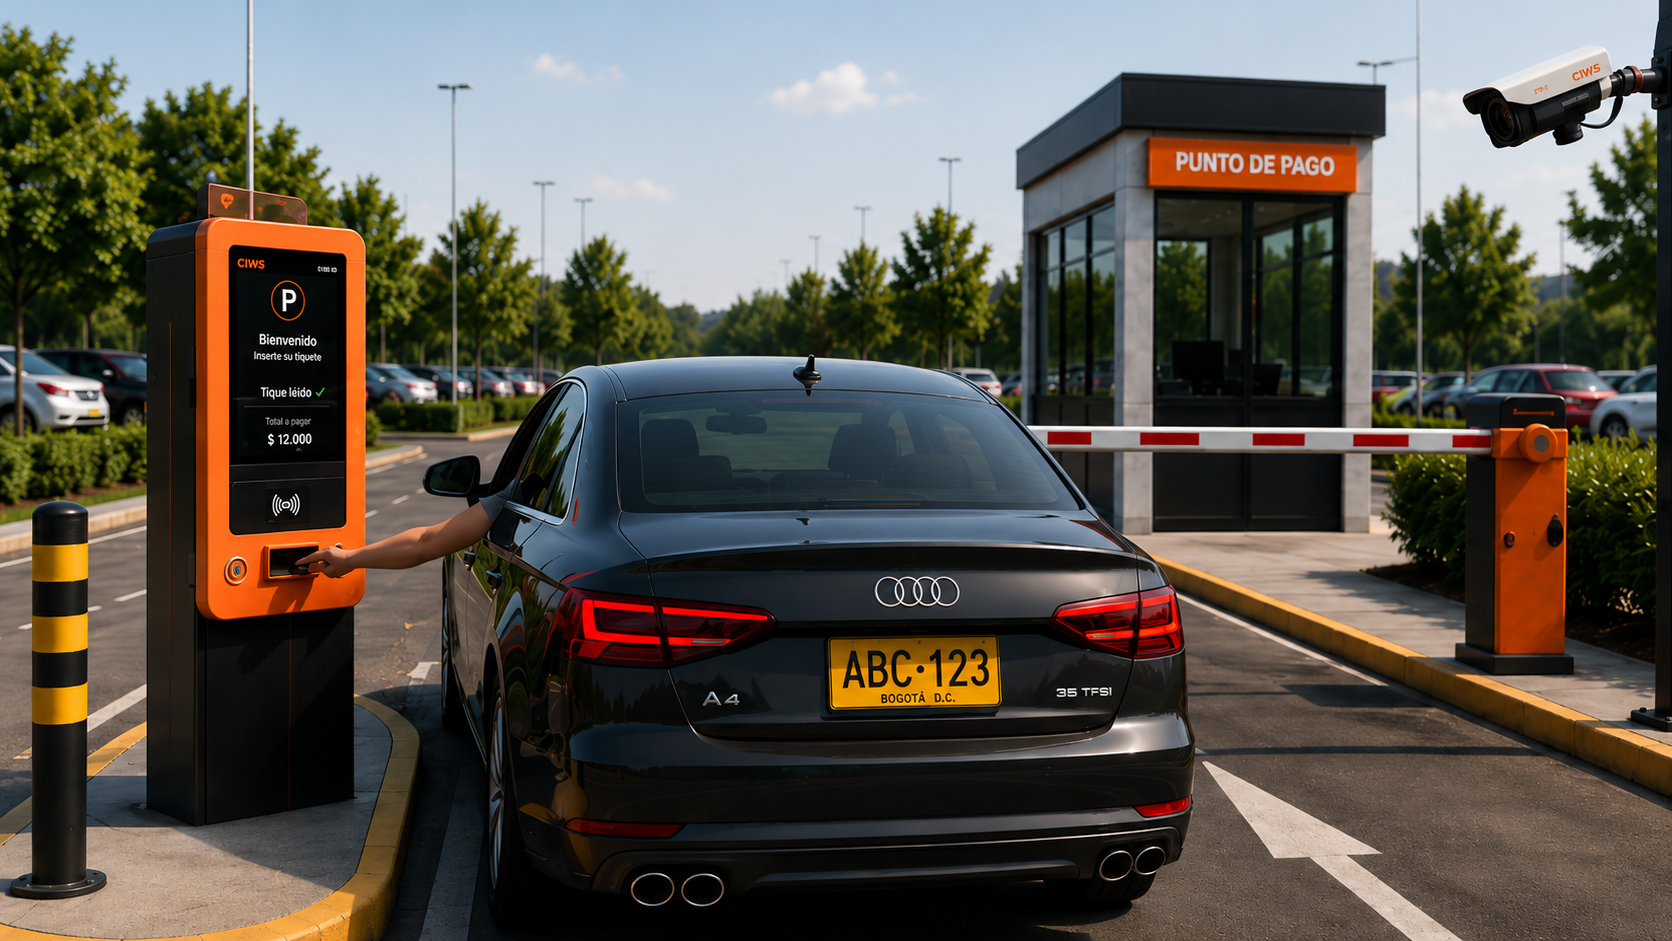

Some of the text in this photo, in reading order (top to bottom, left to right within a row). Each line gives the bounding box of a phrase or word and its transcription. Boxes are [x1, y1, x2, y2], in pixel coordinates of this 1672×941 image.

[1572, 63, 1601, 82] CIWS
[1176, 151, 1335, 177] PUNTO DE PAGO
[237, 258, 265, 270] CIWS
[282, 288, 297, 312] P
[259, 333, 317, 347] Bienvenido
[253, 351, 322, 363] Inserte su tiquete
[260, 387, 287, 400] Tique
[265, 417, 312, 427] Total a pagar
[267, 433, 312, 446] $ 12.000
[880, 691, 956, 704] BOGOTÁ D.C.
[1056, 686, 1112, 698] 35 TFSI
[701, 691, 740, 707] A4
